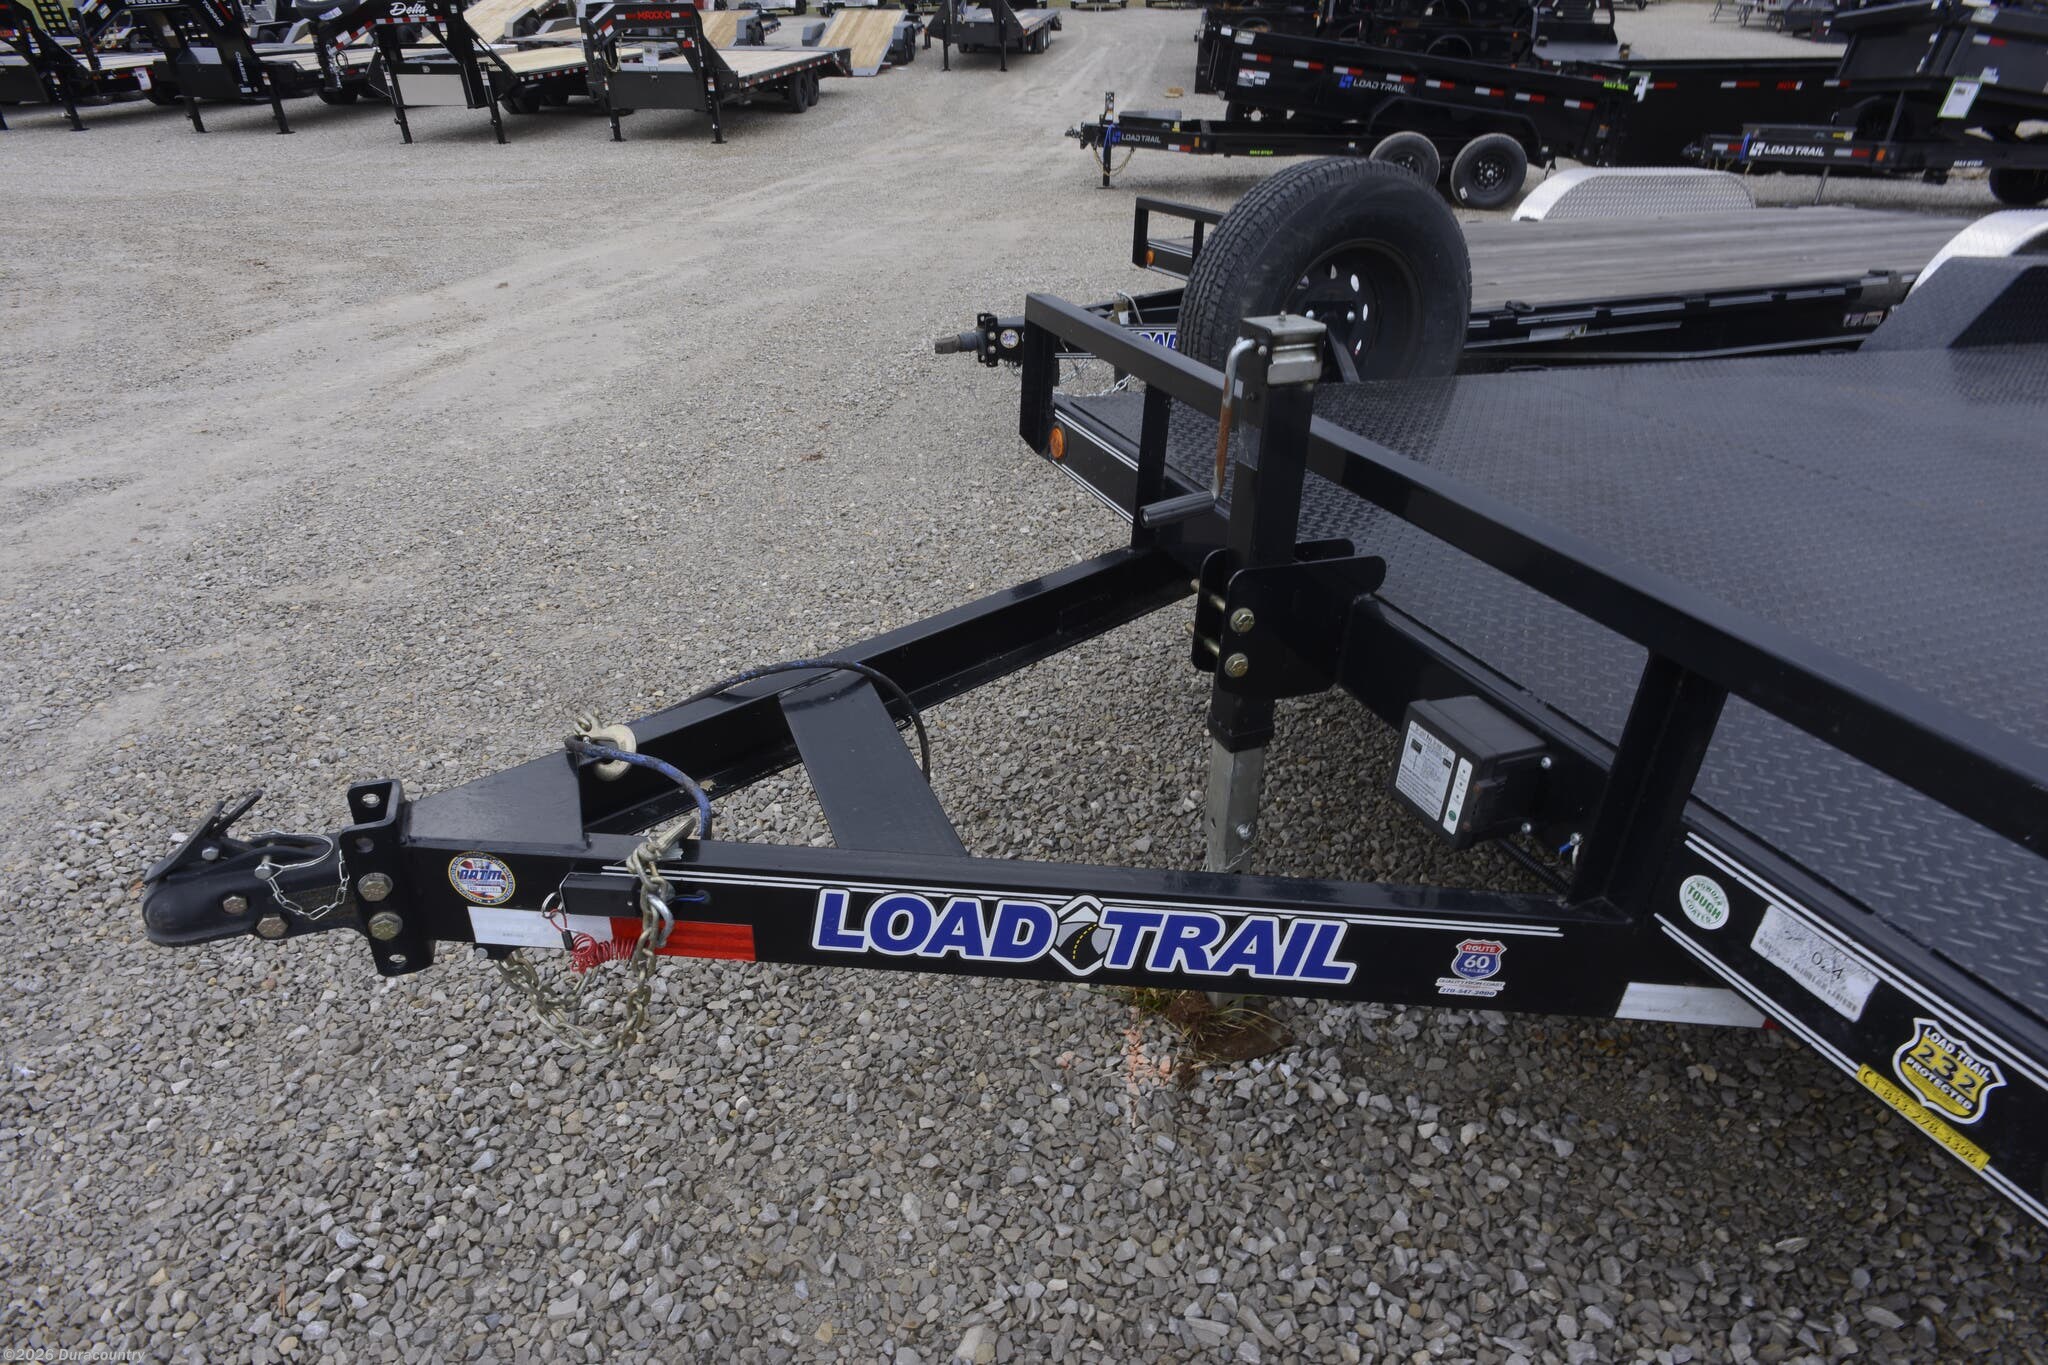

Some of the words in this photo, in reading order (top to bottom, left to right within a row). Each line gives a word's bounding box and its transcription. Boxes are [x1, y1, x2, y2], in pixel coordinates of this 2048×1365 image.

[389, 2, 427, 16] Delta
[1353, 79, 1379, 90] LOAD
[1380, 83, 1406, 94] TRAIL
[1121, 133, 1142, 142] LOAD
[1142, 135, 1161, 144] TRAIL
[1764, 144, 1794, 155] LOAD
[1795, 145, 1824, 157] TRAIL
[1687, 885, 1722, 920] TOUGH
[811, 886, 1059, 962] LOAD
[1100, 903, 1358, 985] TRAIL
[1465, 944, 1497, 953] ROUTE
[1463, 955, 1490, 969] 60
[1924, 1026, 1956, 1055] LOAD
[1957, 1050, 1992, 1082] TRAIL
[1917, 1043, 1978, 1095] 232
[1904, 1056, 1974, 1111] PROTECTED
